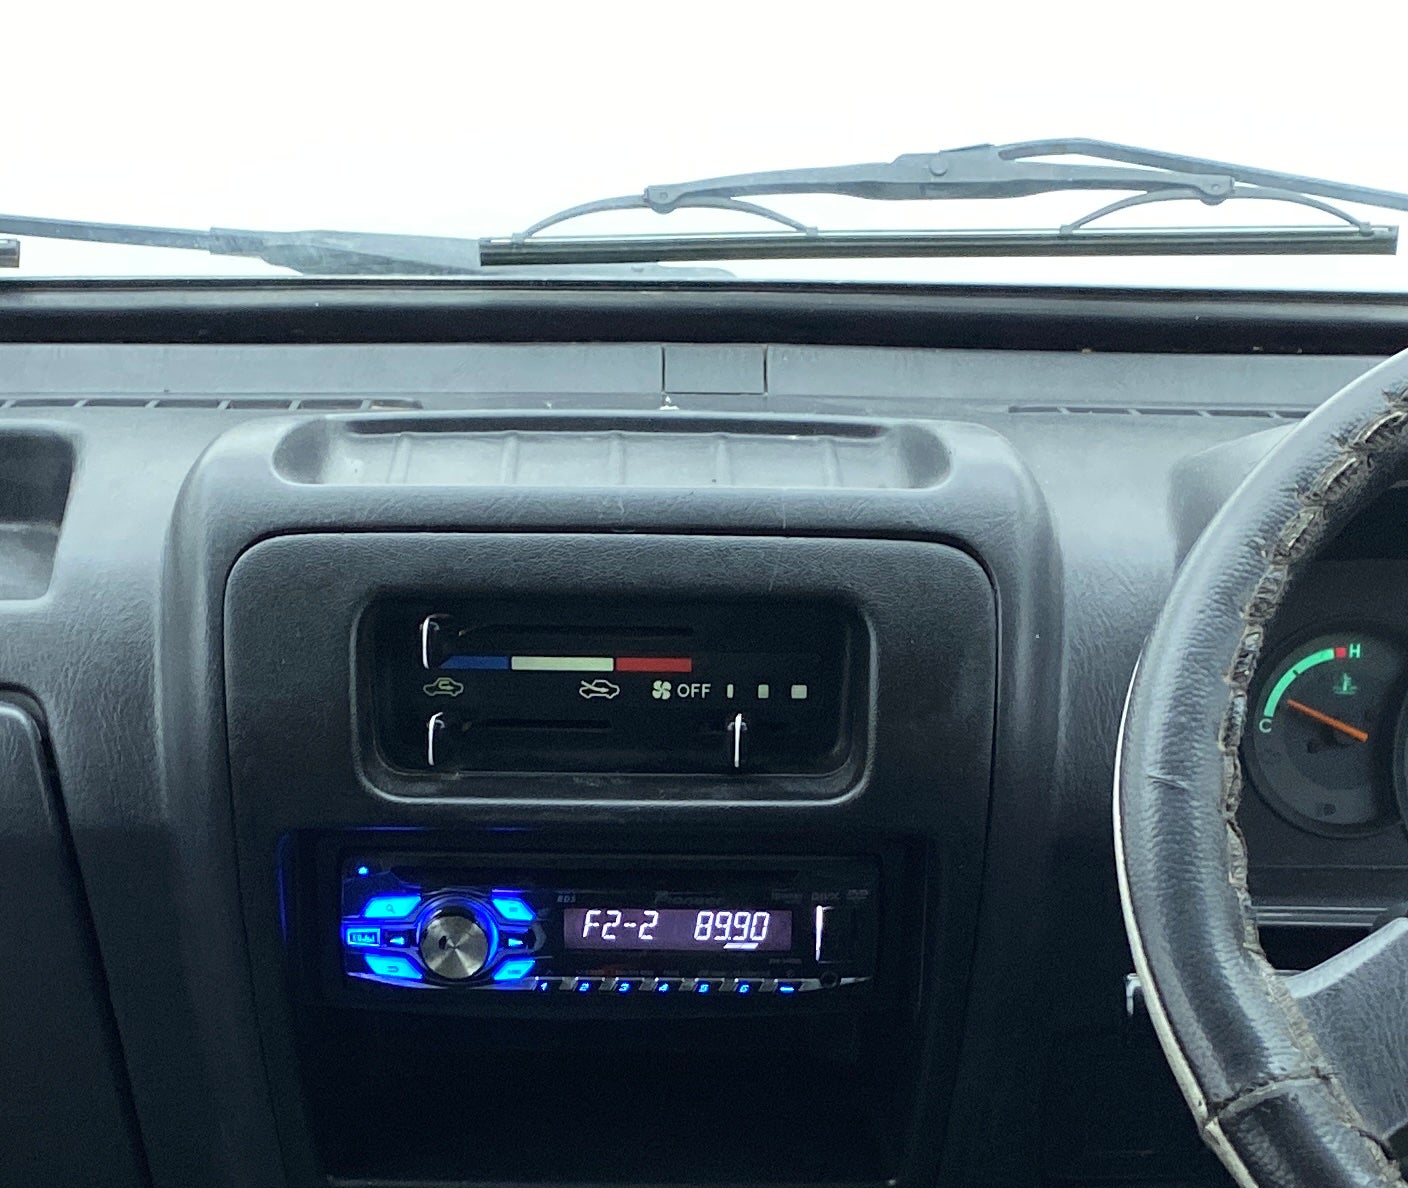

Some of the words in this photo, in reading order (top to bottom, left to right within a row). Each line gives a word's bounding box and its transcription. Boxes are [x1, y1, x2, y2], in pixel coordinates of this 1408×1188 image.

[1349, 643, 1361, 658] H
[676, 683, 712, 699] OFF
[1258, 718, 1273, 733] C
[582, 909, 659, 940] F2-2
[579, 982, 590, 992] 2
[618, 982, 630, 992] 3
[658, 983, 669, 993] 4
[699, 983, 709, 993] 5
